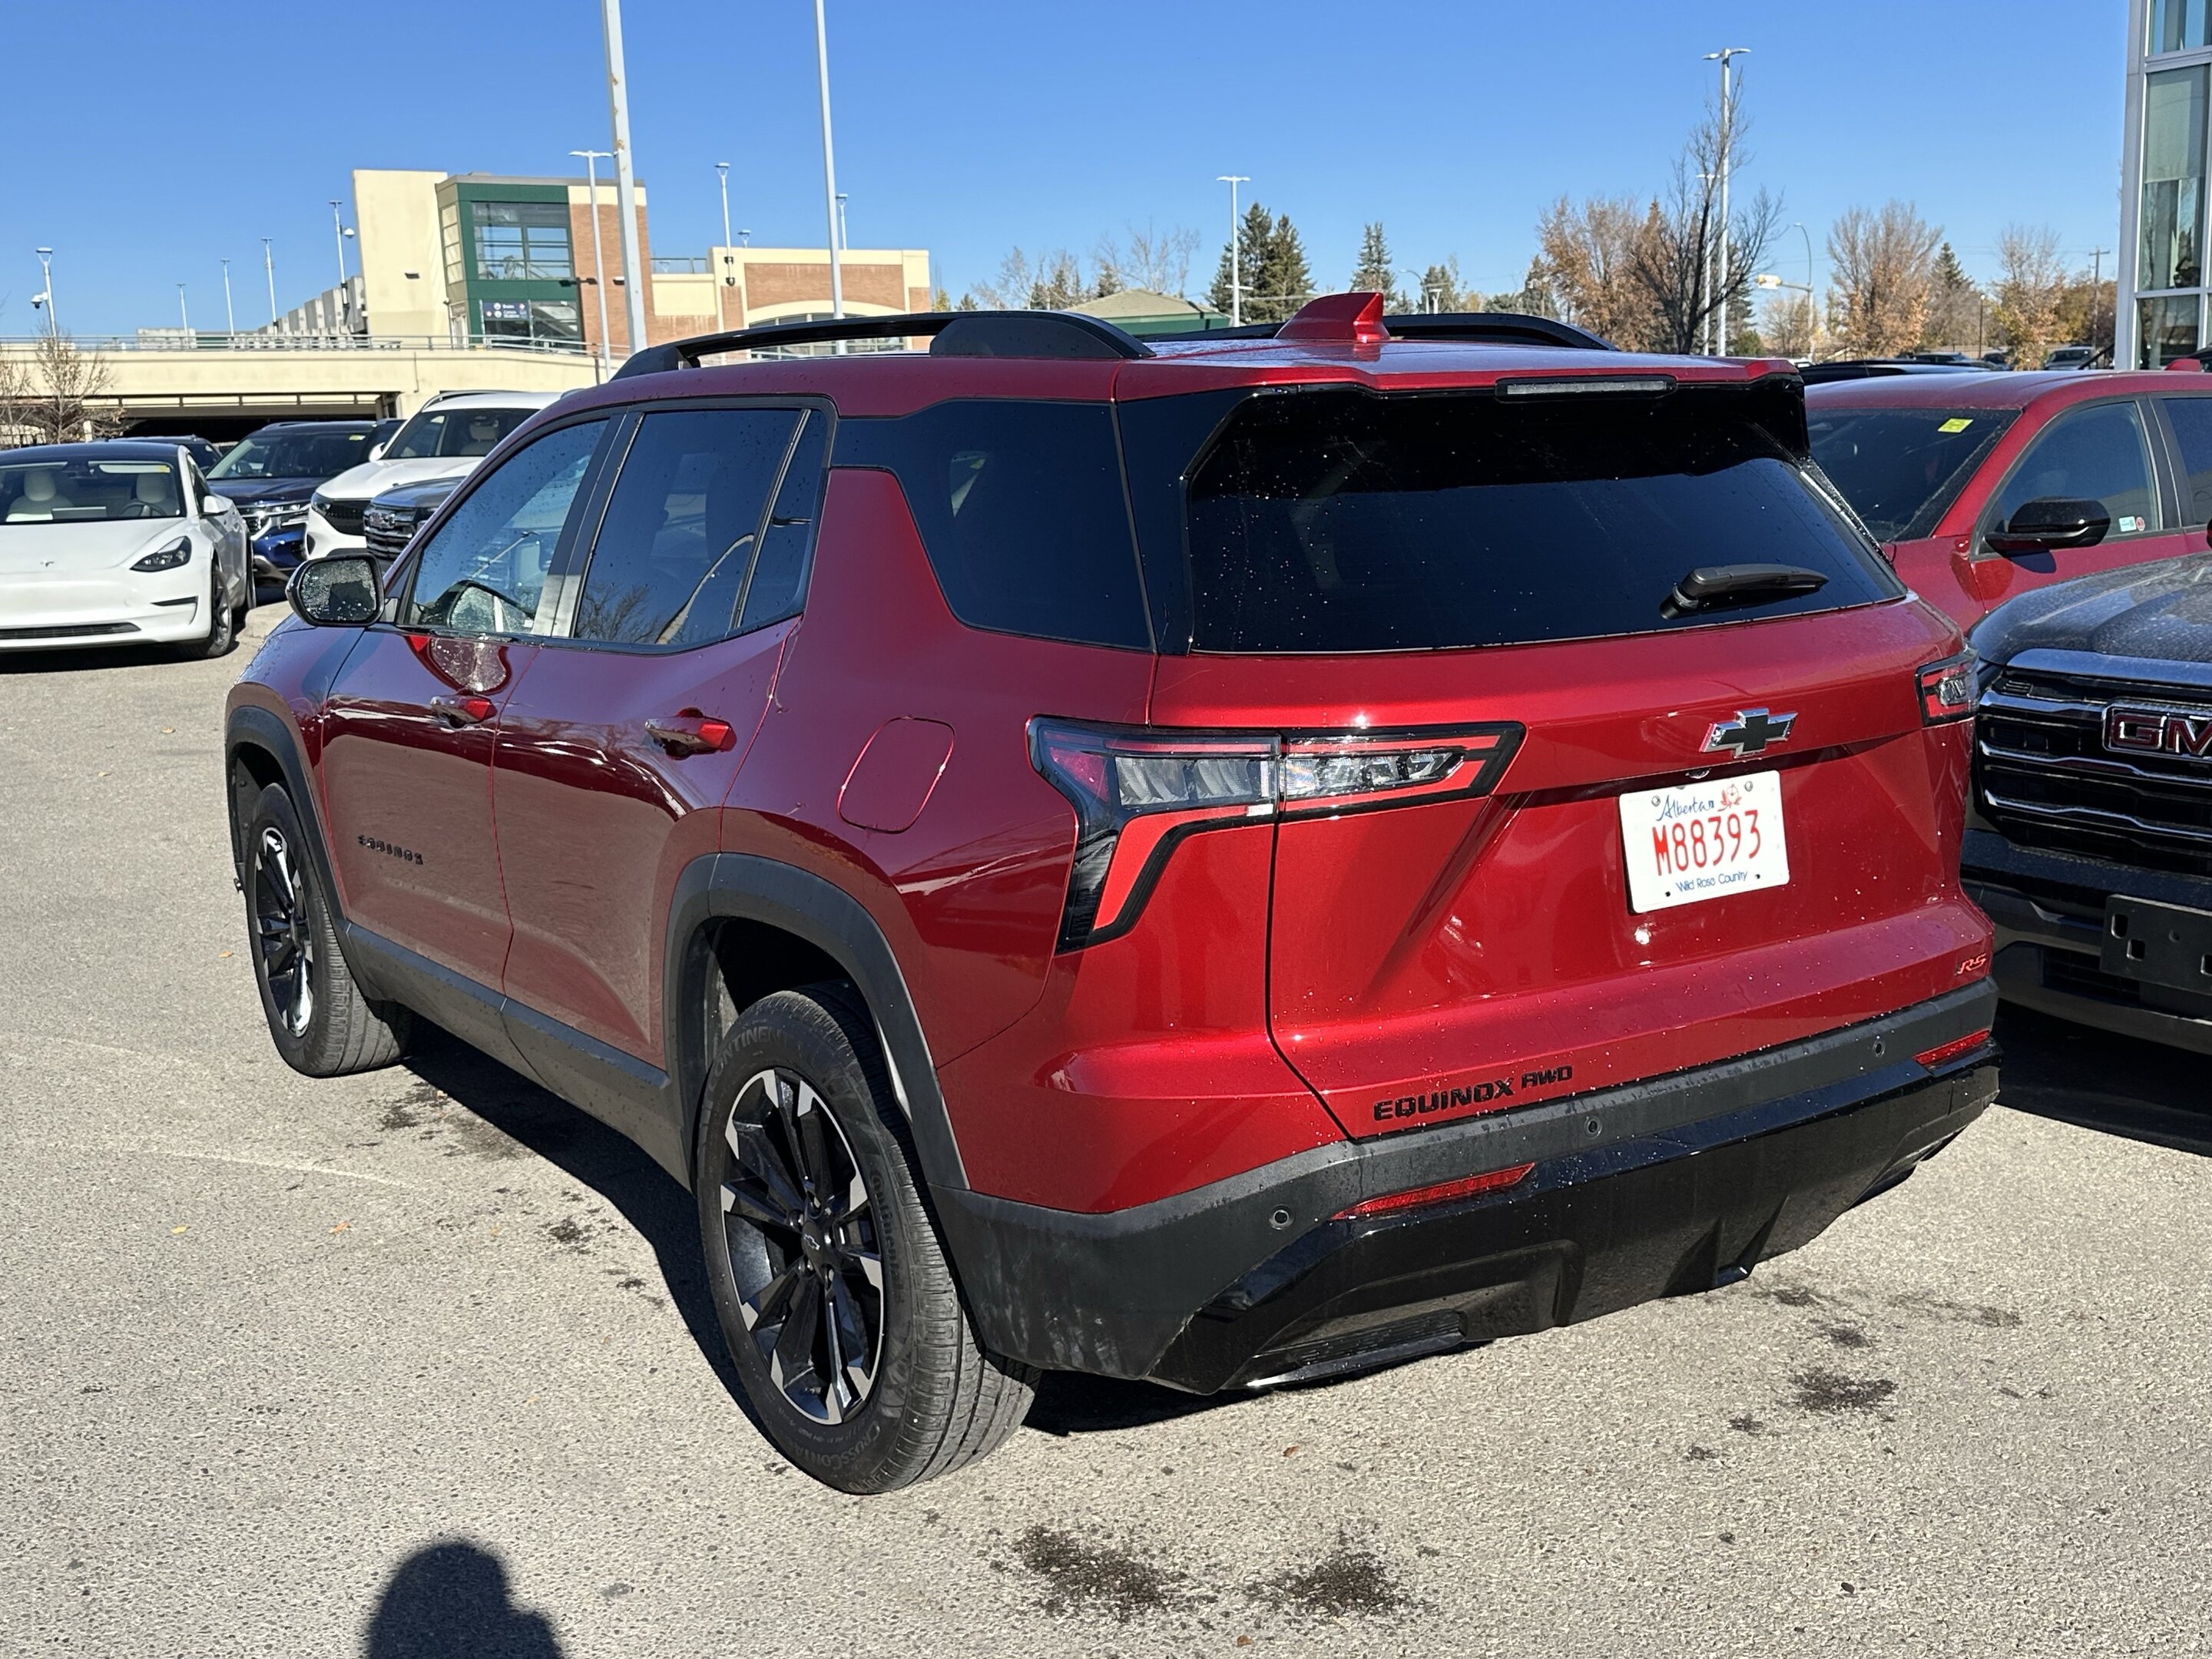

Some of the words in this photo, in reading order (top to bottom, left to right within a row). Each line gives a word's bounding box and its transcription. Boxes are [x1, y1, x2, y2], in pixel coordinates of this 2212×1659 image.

[1652, 810, 1760, 876] M88393
[1718, 870, 1748, 885] County
[1954, 953, 1987, 975] RS
[1373, 1078, 1514, 1121] EQUINOX
[1521, 1065, 1572, 1089] AWD
